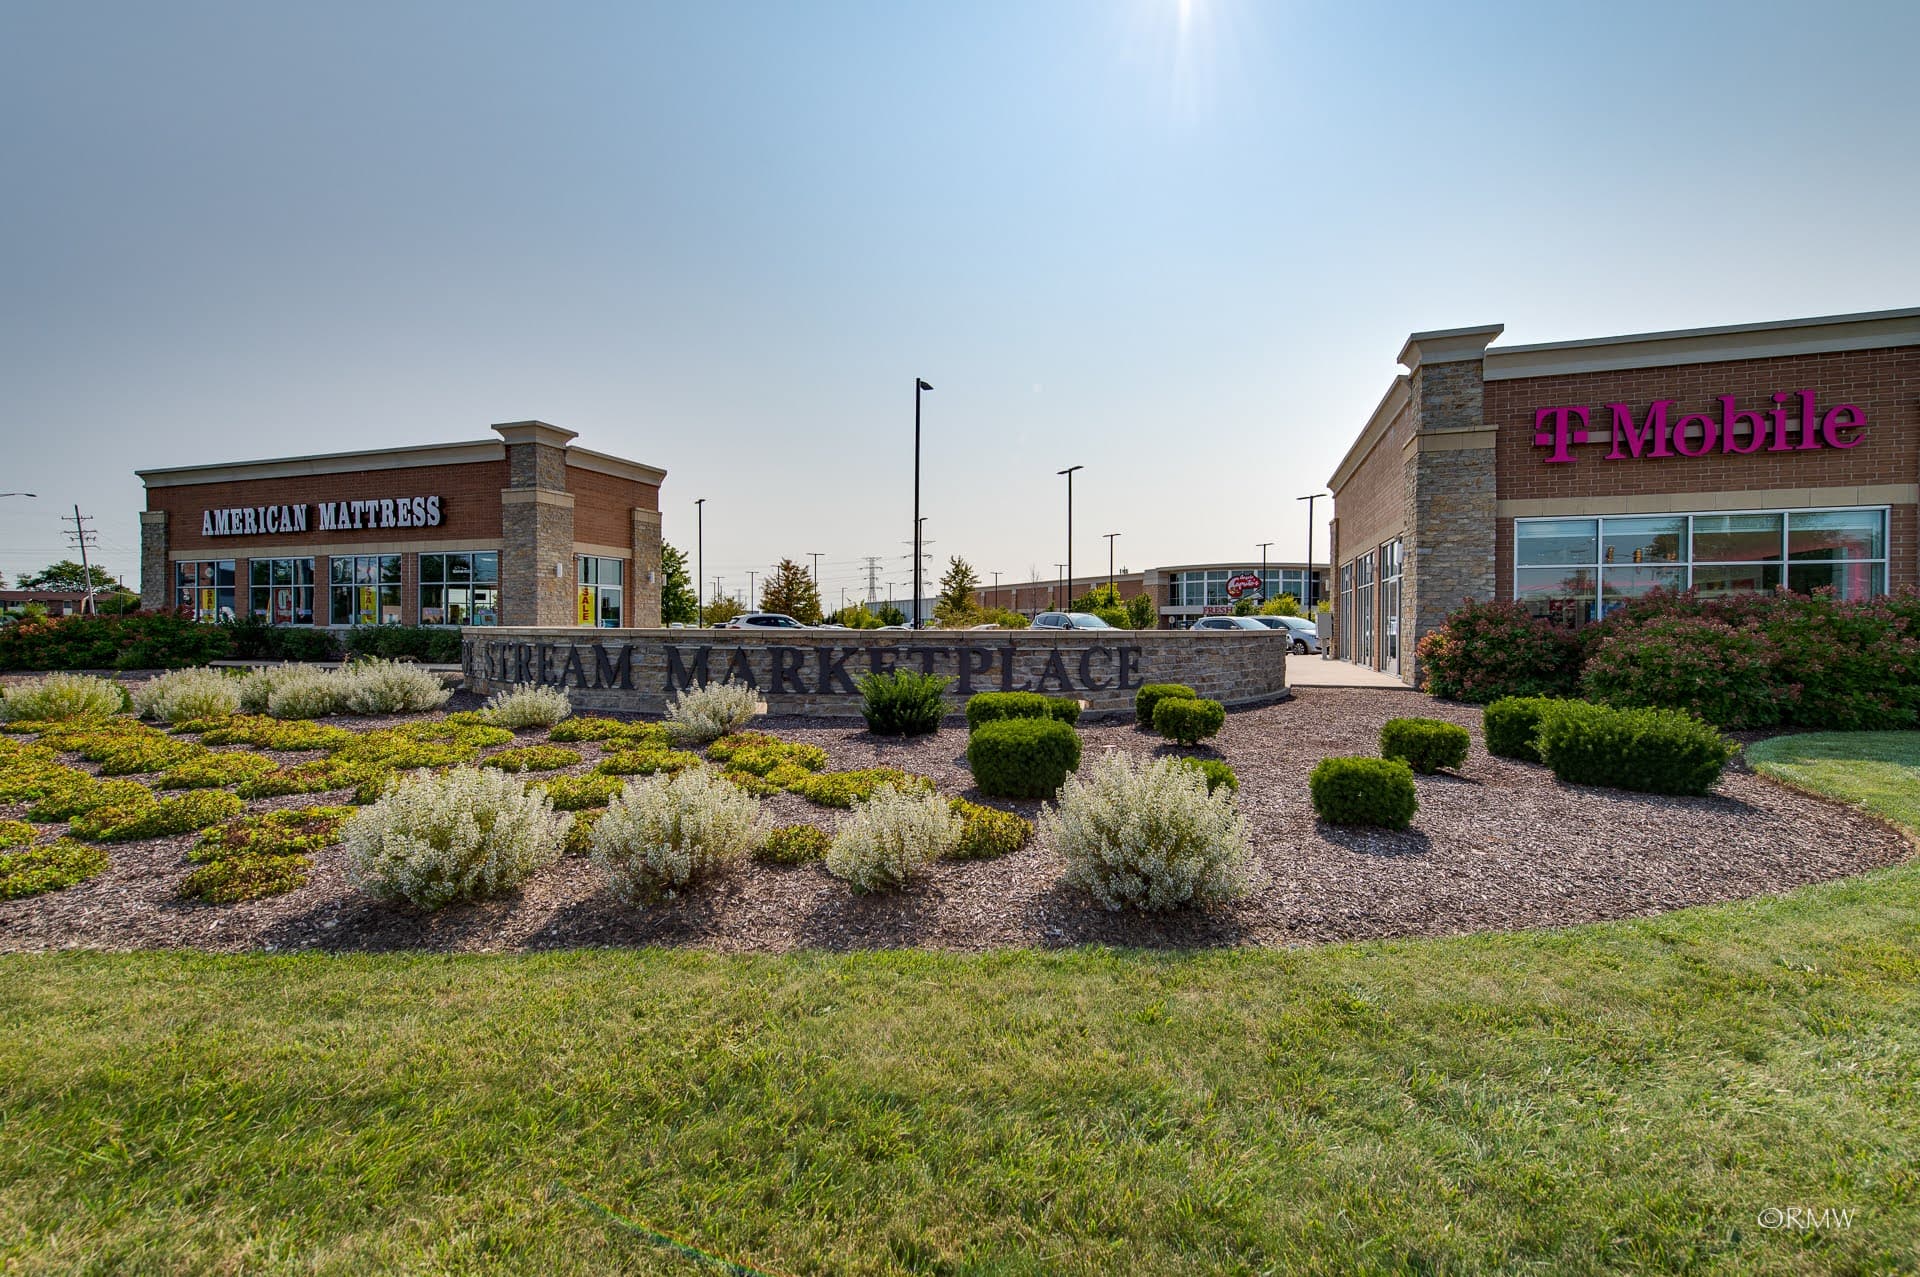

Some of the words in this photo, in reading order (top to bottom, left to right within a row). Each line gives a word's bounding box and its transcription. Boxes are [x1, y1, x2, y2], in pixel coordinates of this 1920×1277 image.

[1604, 388, 1868, 460] Mobile
[201, 503, 308, 537] AMERICAN
[318, 495, 442, 531] MATTRESS
[582, 587, 590, 621] SALE
[1203, 606, 1233, 615] FRESH
[485, 641, 637, 690] STREAM
[663, 644, 1144, 695] MARKETPLACE
